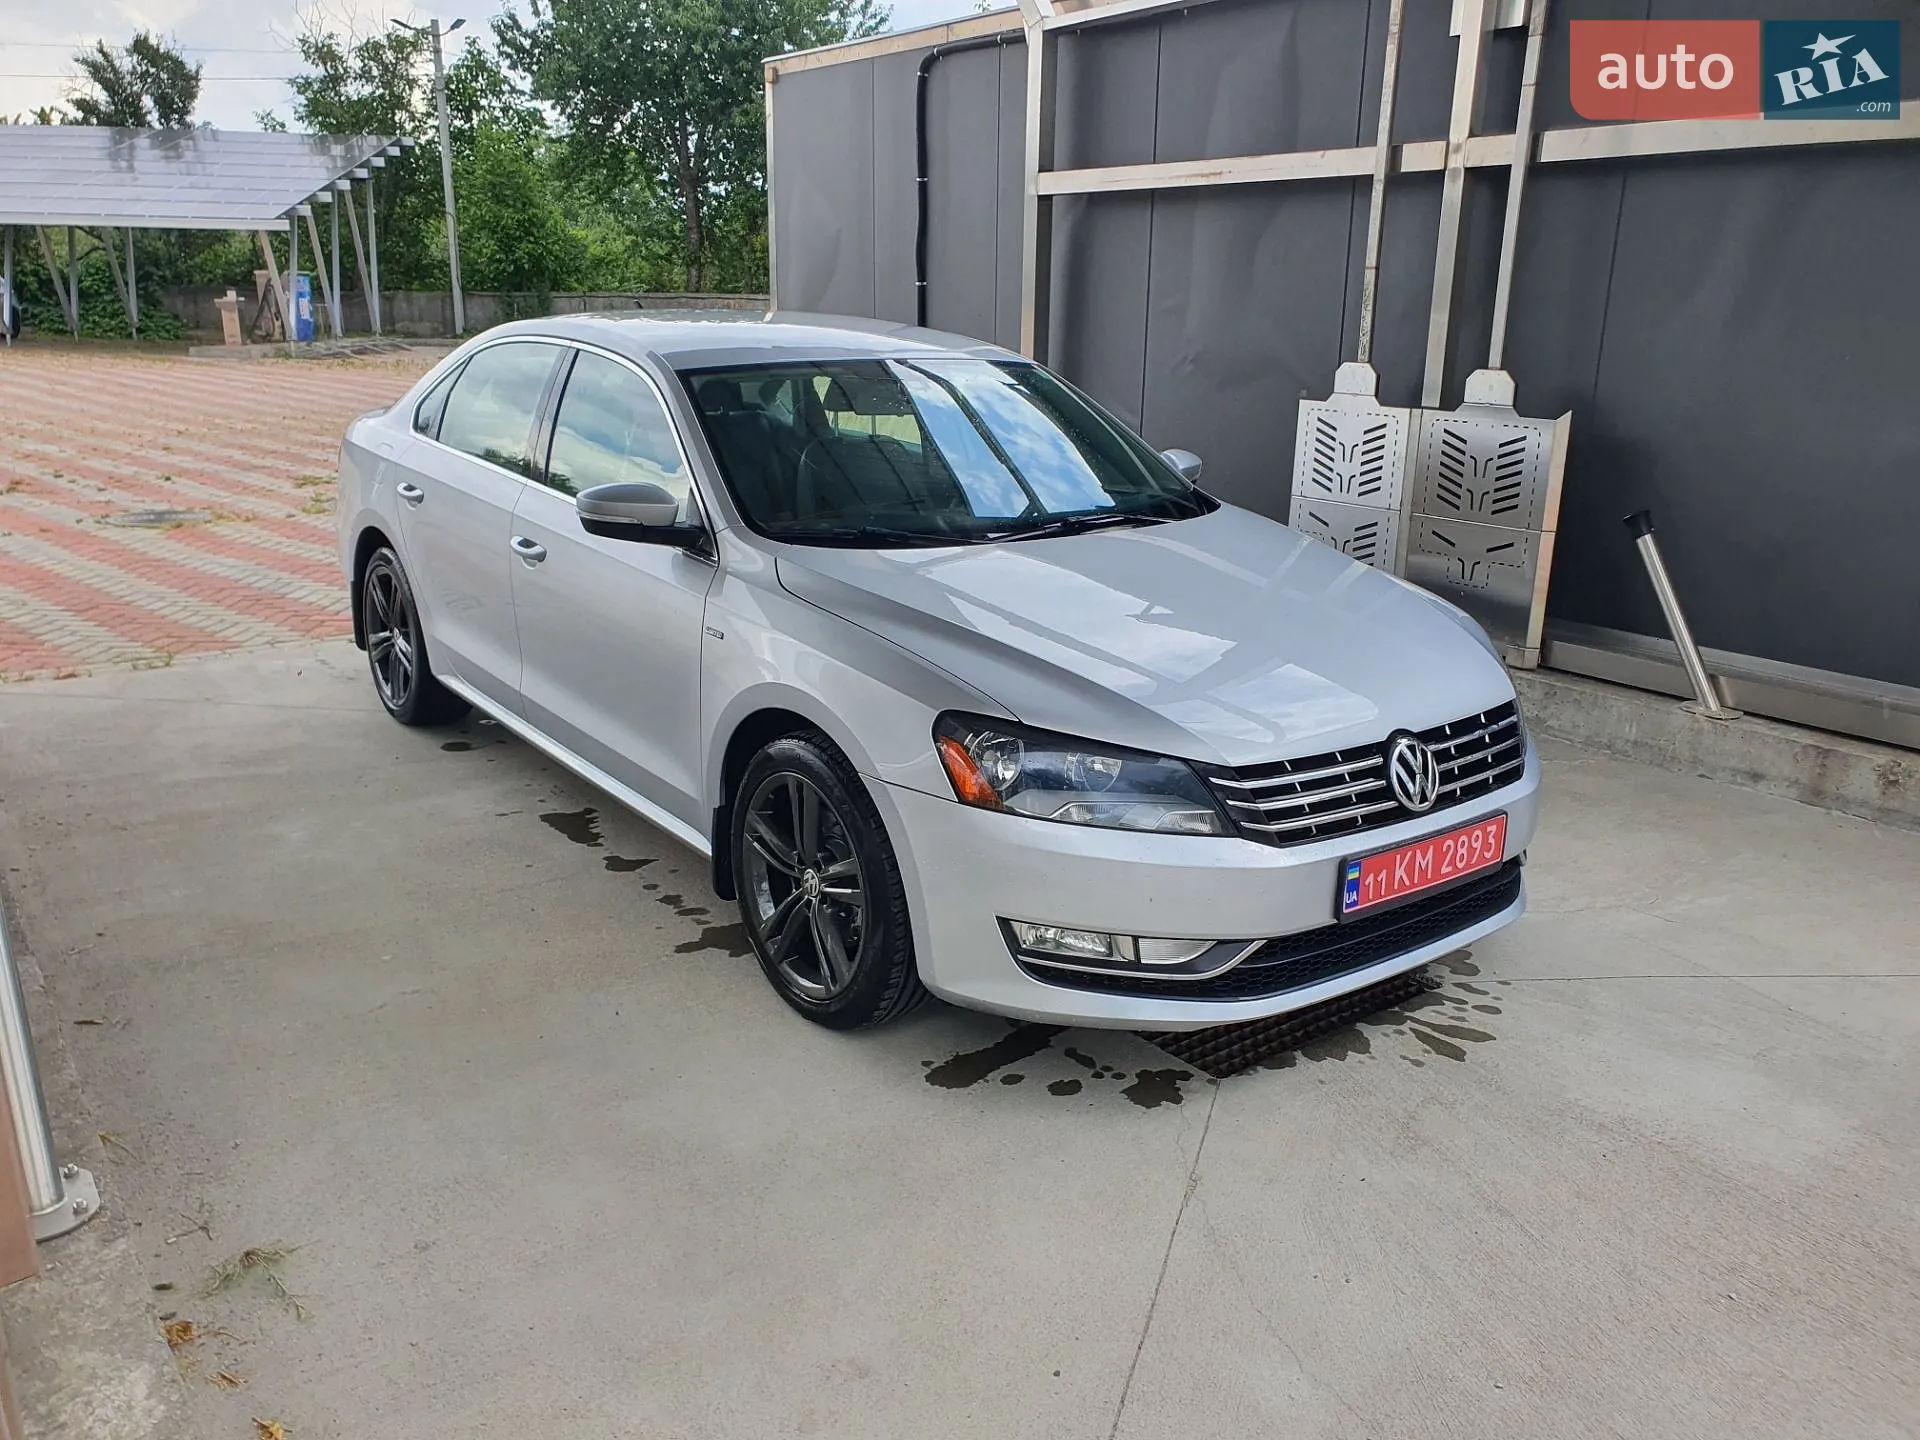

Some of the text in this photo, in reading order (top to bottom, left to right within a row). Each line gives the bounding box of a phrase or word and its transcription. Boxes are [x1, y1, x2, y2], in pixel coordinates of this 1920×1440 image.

[1364, 824, 1497, 899] 11 KM 2893
[1346, 890, 1358, 904] UA
